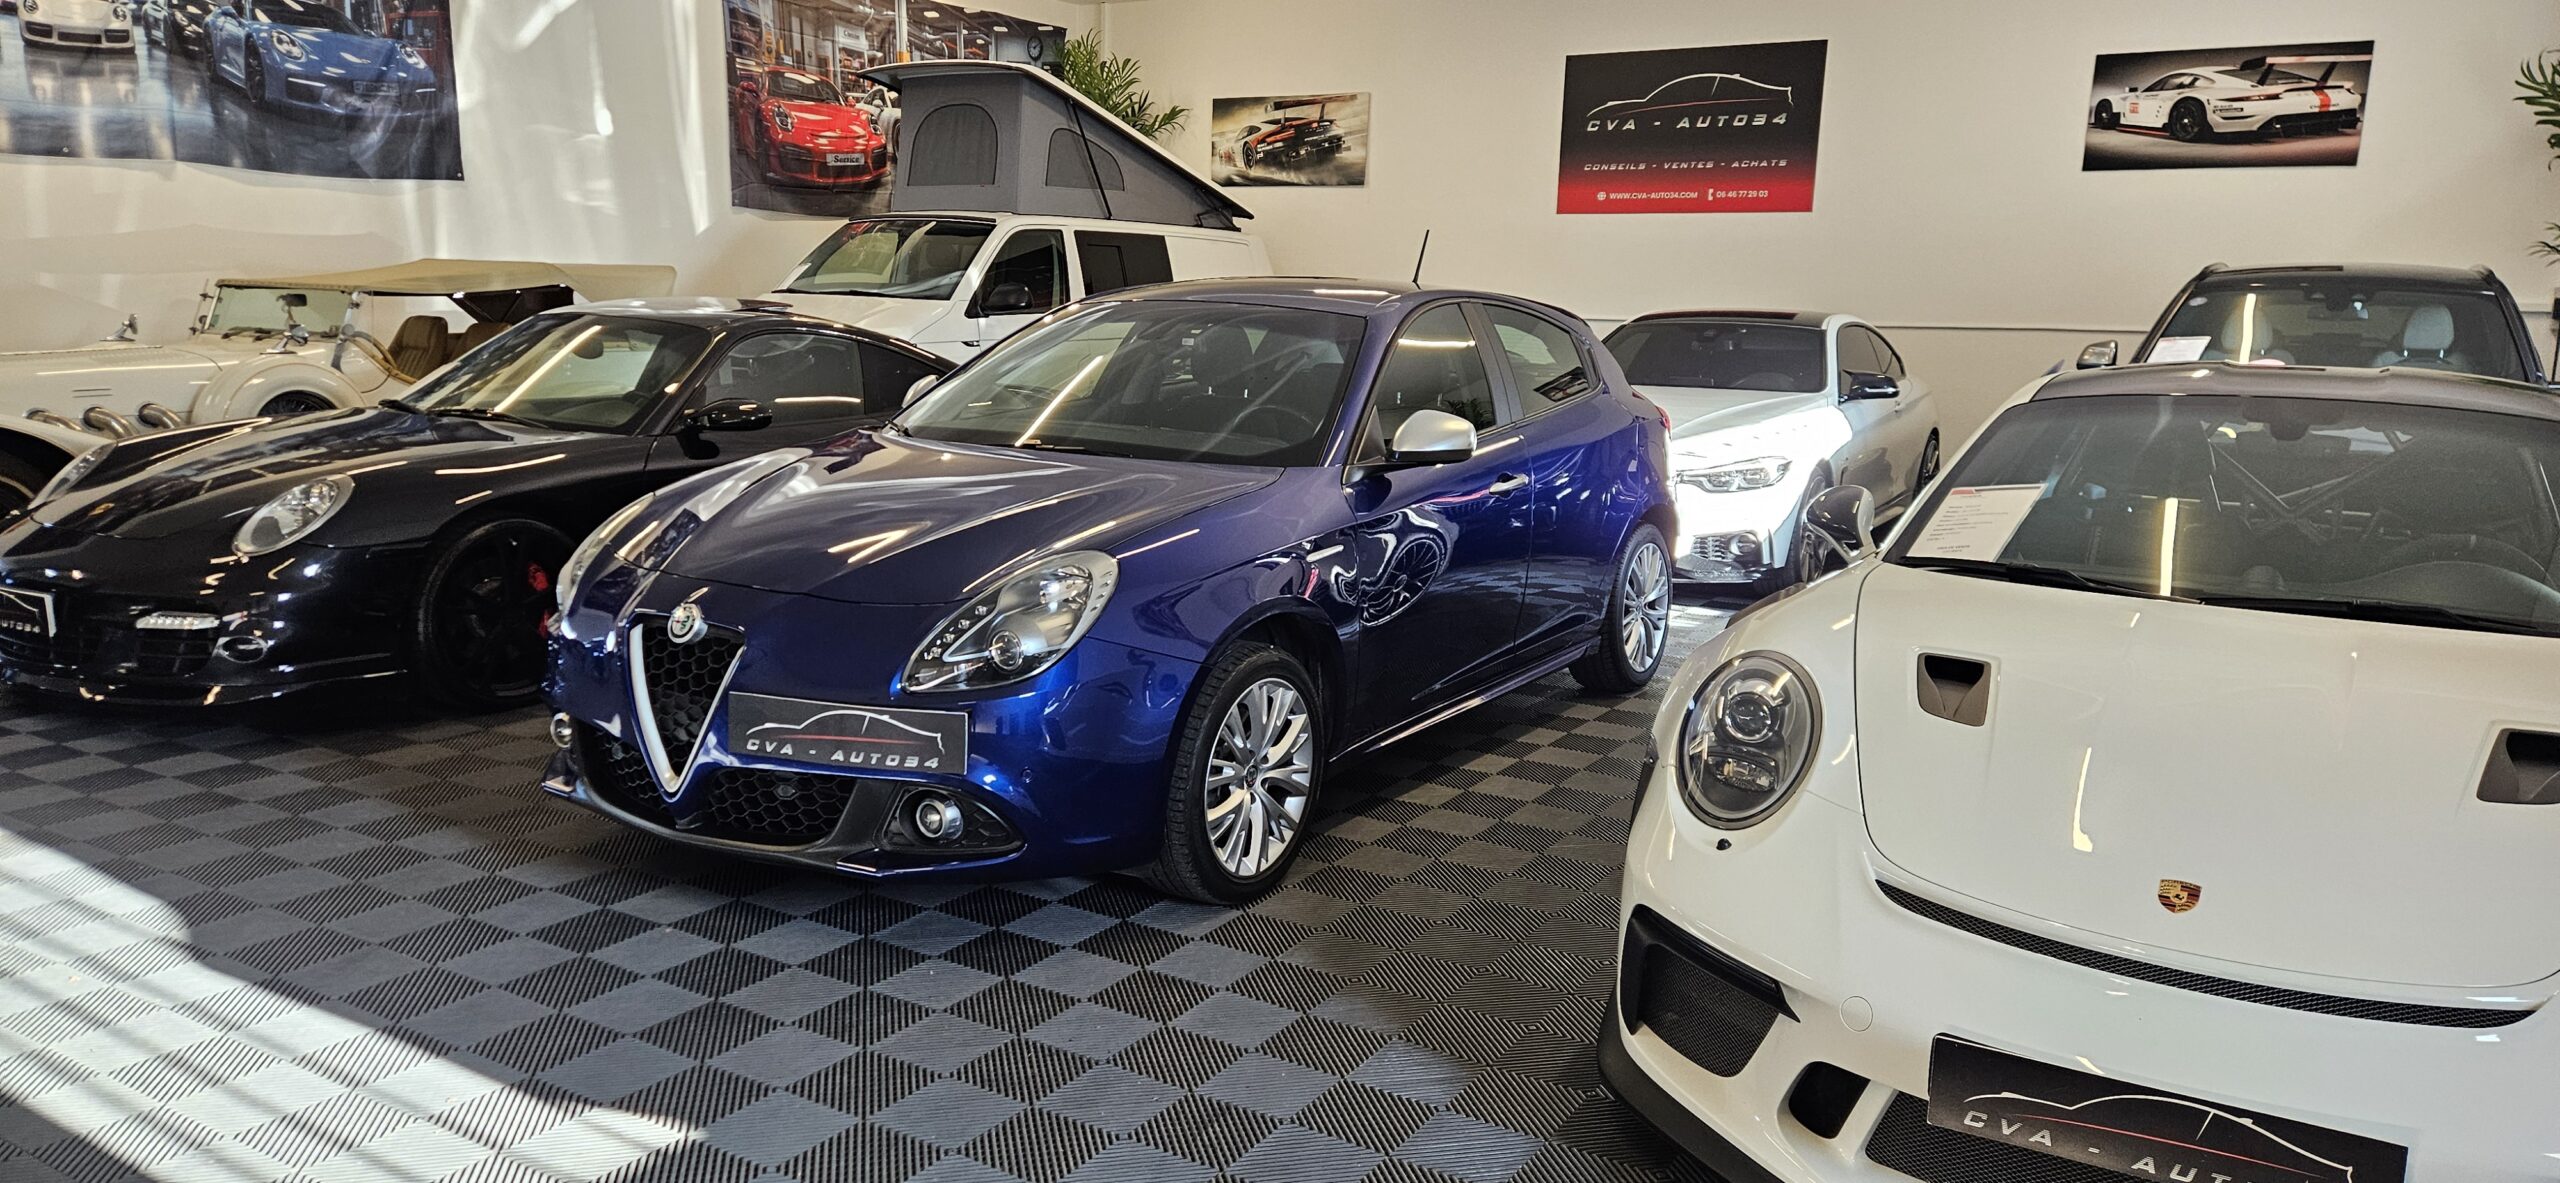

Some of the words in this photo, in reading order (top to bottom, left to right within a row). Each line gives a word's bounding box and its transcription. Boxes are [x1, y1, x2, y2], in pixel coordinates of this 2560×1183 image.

[1587, 119, 1635, 131] CVA
[1676, 112, 1788, 129] AUTO34
[1584, 163, 1647, 171] CONSEILS
[1663, 161, 1715, 169] VENTES
[1731, 159, 1789, 168] ACHATS
[1609, 191, 1699, 199] WWW.CVA-AUTO34.COM
[1716, 190, 1727, 198] 06
[1727, 190, 1738, 198] 46
[1738, 190, 1748, 198] 77
[1748, 190, 1758, 198] 29
[1758, 190, 1769, 198] 03
[0, 618, 41, 633] UTO34
[746, 739, 793, 755] CVA
[830, 749, 940, 769] AUTO34
[1963, 1110, 2052, 1147] CVA
[2131, 1156, 2252, 1183] AUT
